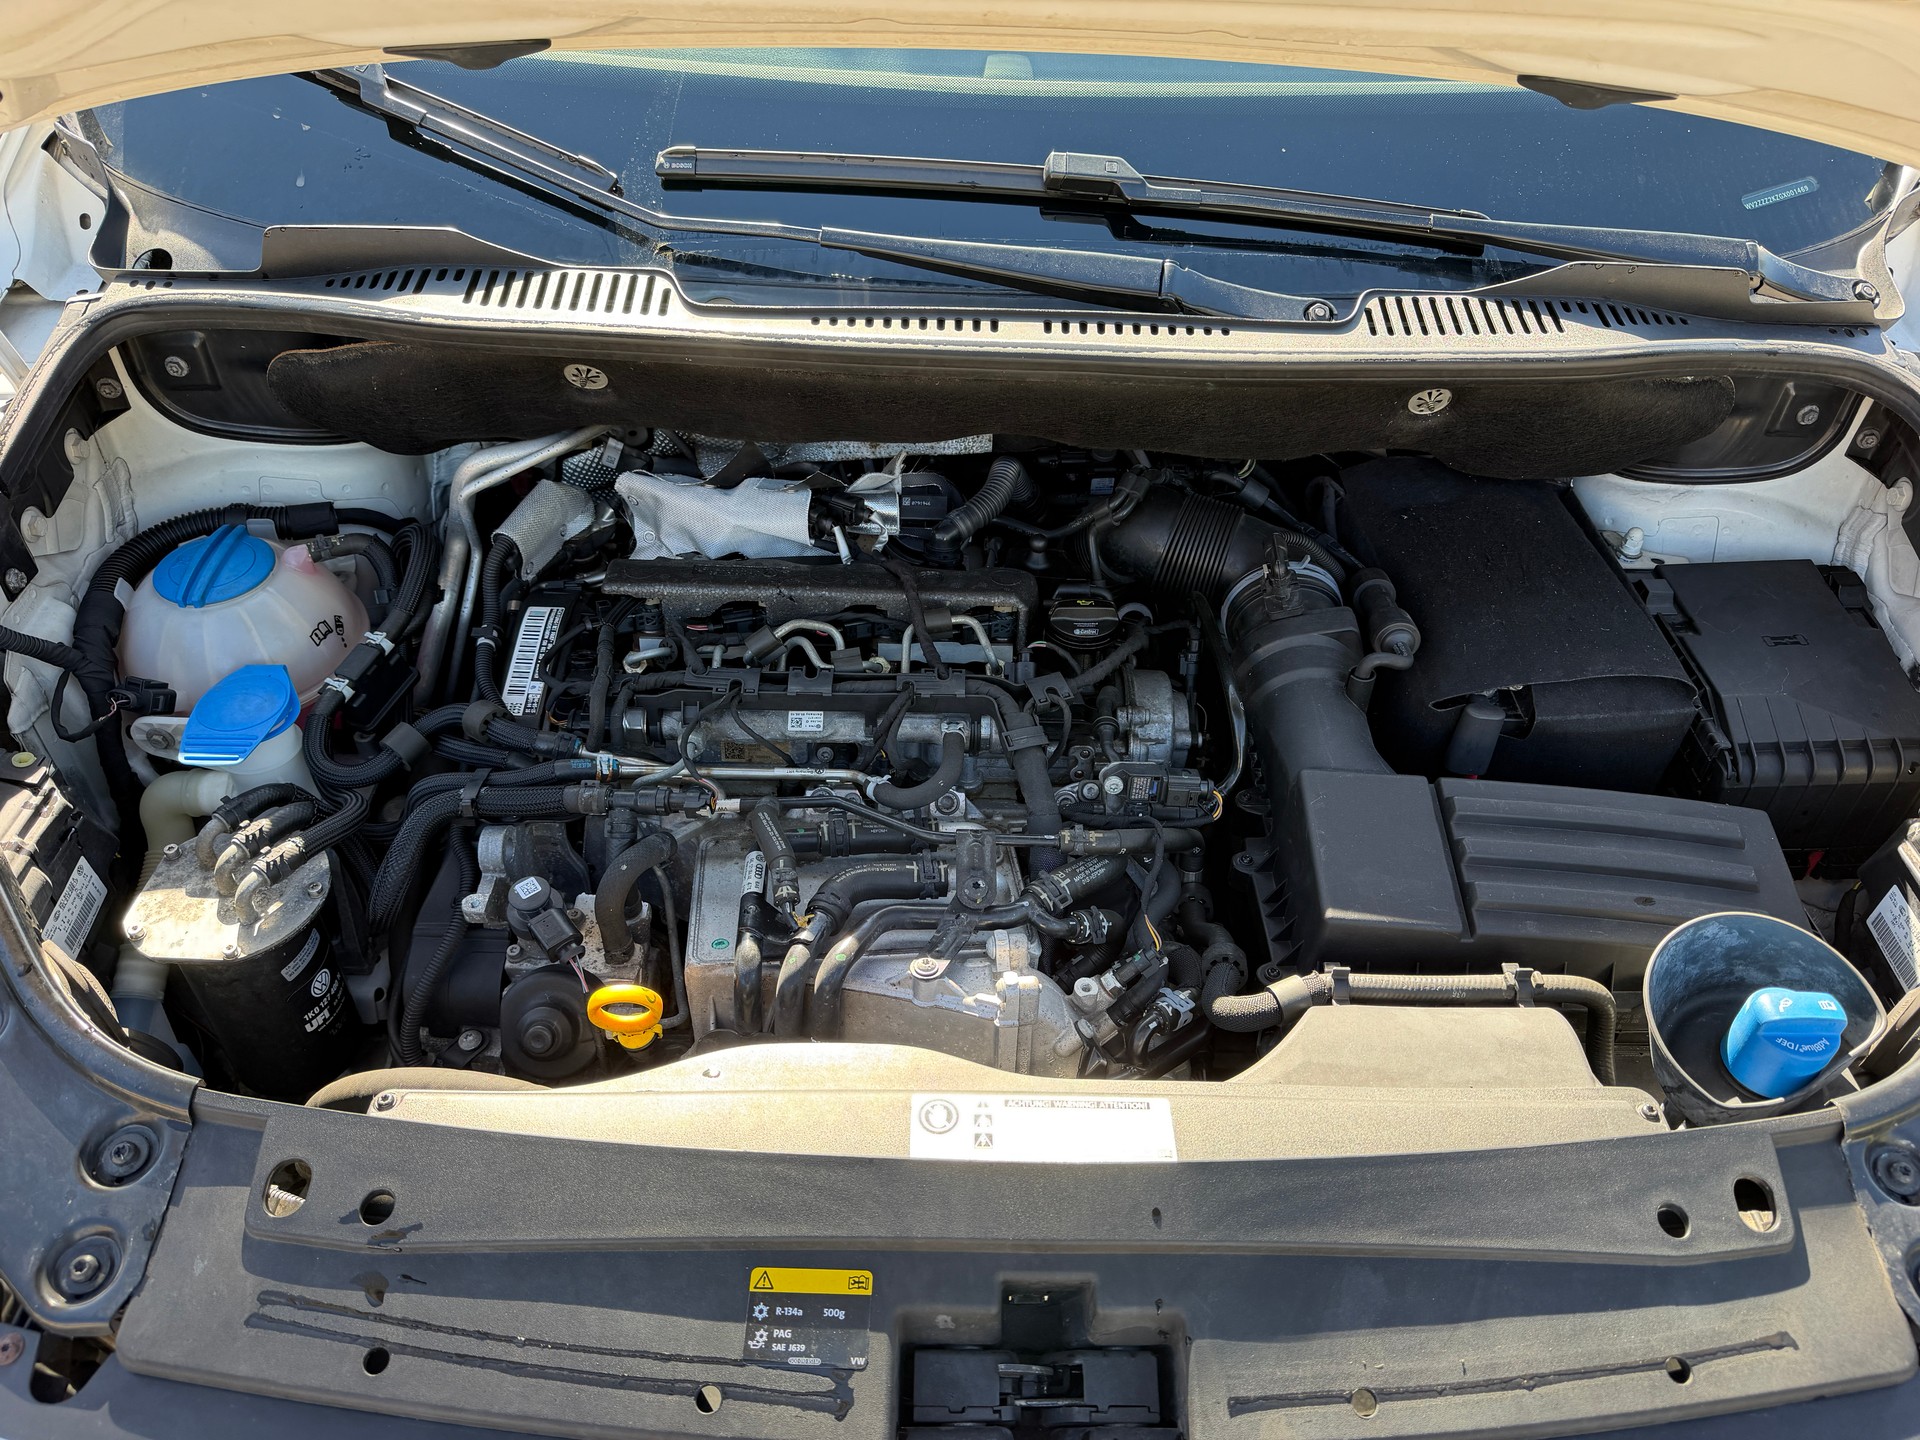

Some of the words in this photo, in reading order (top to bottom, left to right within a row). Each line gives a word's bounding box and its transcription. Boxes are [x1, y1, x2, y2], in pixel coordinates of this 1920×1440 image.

[320, 993, 331, 1008] 127
[304, 1008, 331, 1033] UFI
[776, 1307, 803, 1316] R-134a
[823, 1308, 846, 1320] 500g
[773, 1329, 792, 1338] PAG
[771, 1343, 786, 1351] SAE
[788, 1344, 806, 1352] J639
[850, 1357, 866, 1365] VW
